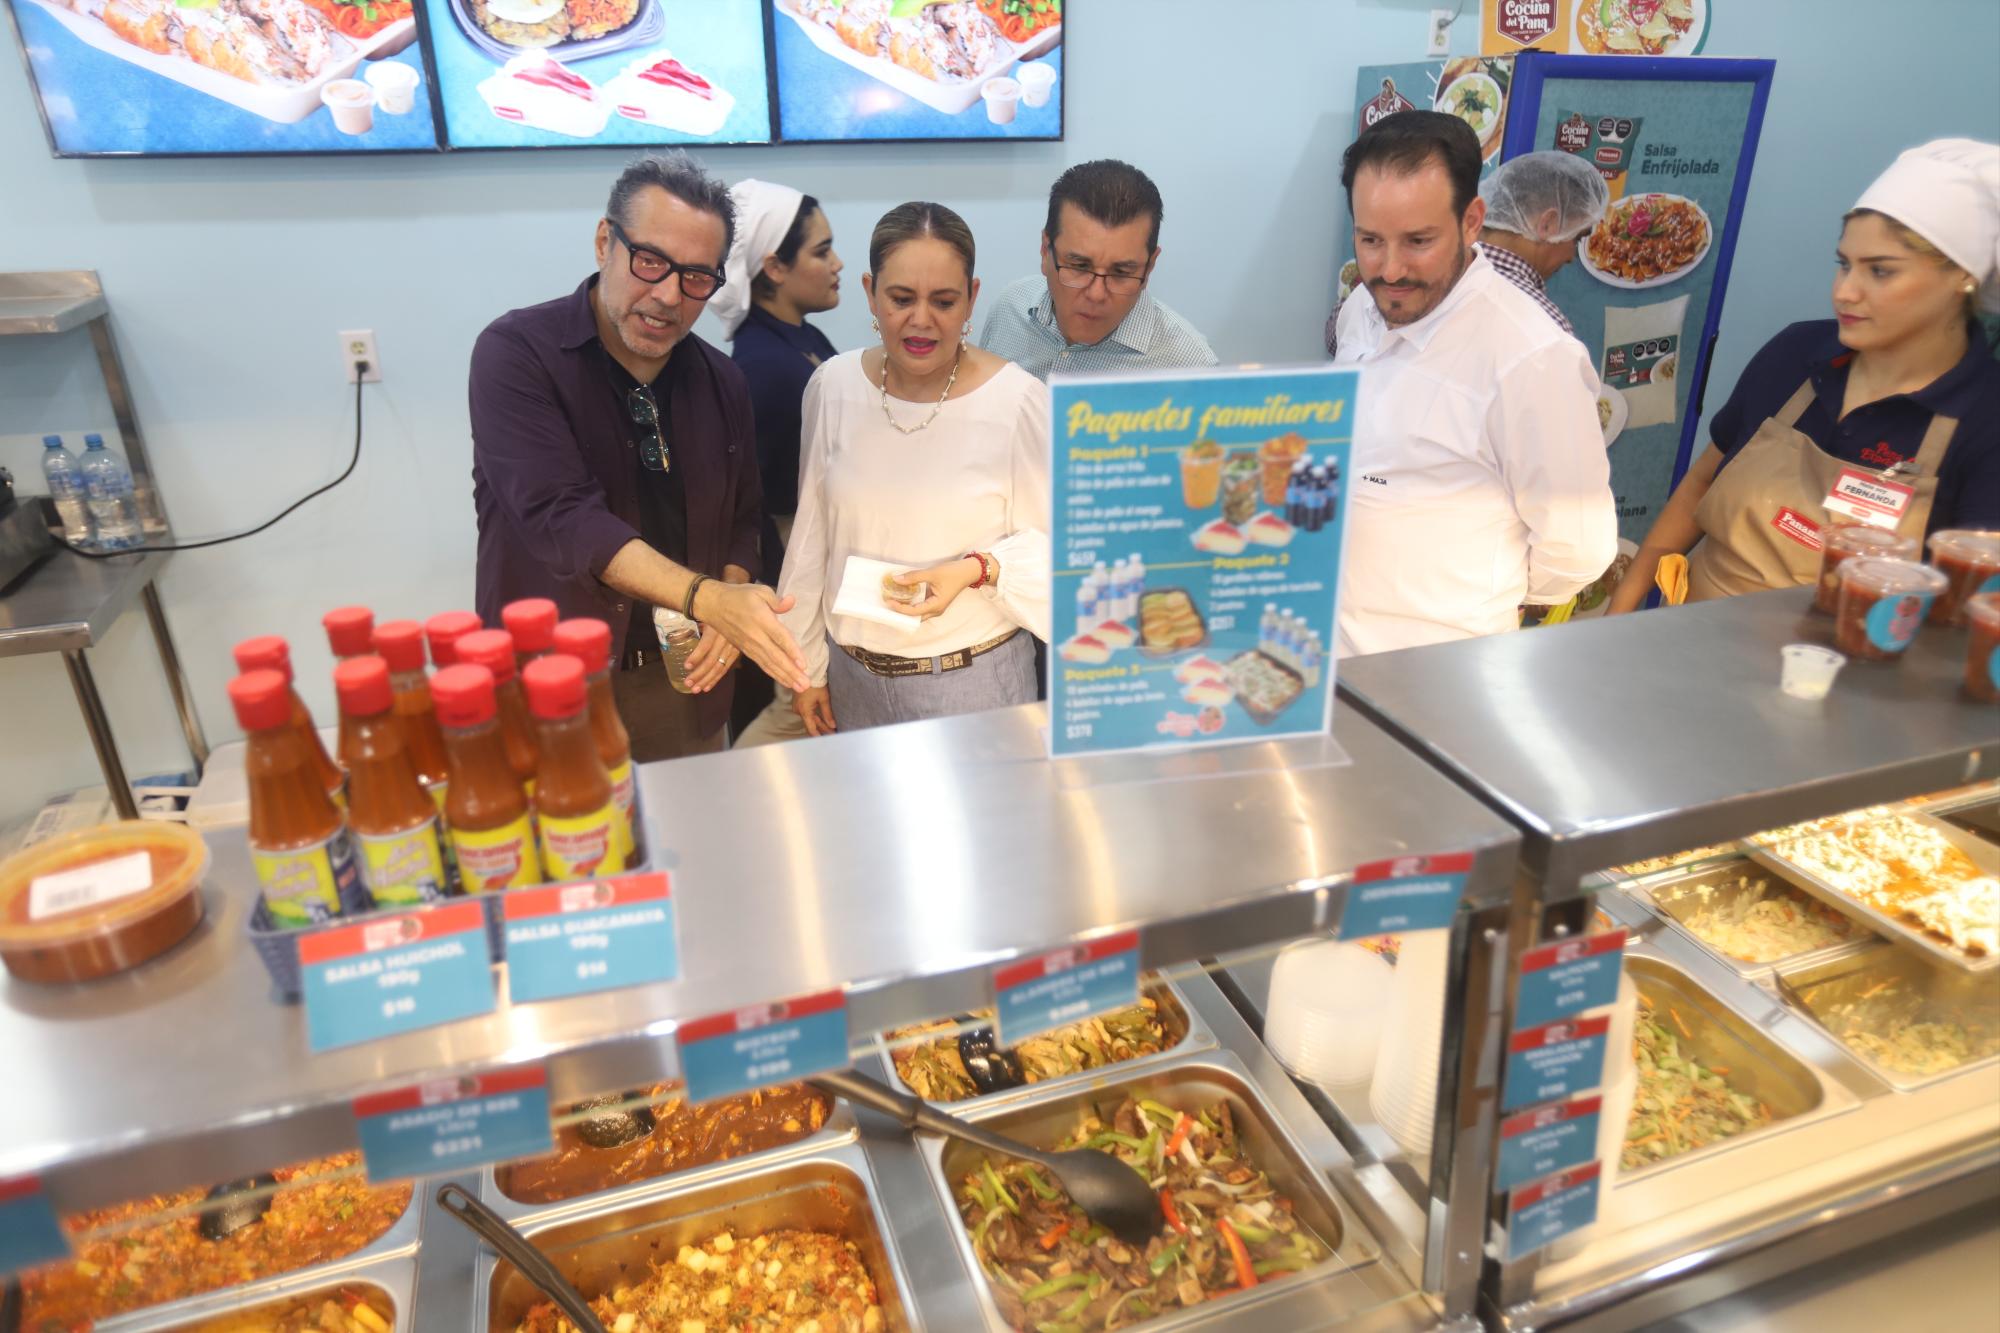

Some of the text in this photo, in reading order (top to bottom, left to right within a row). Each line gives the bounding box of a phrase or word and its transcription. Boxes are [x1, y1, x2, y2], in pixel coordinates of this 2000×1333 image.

[1506, 17, 1517, 27] del
[1644, 143, 1677, 157] Salsa
[1641, 159, 1720, 178] Enfrijolada
[1068, 395, 1344, 441] Paquetes familiares
[1844, 484, 1897, 507] FERNANDA
[508, 907, 666, 944] SALSA GUACAMAYA
[324, 957, 383, 985] SALSA
